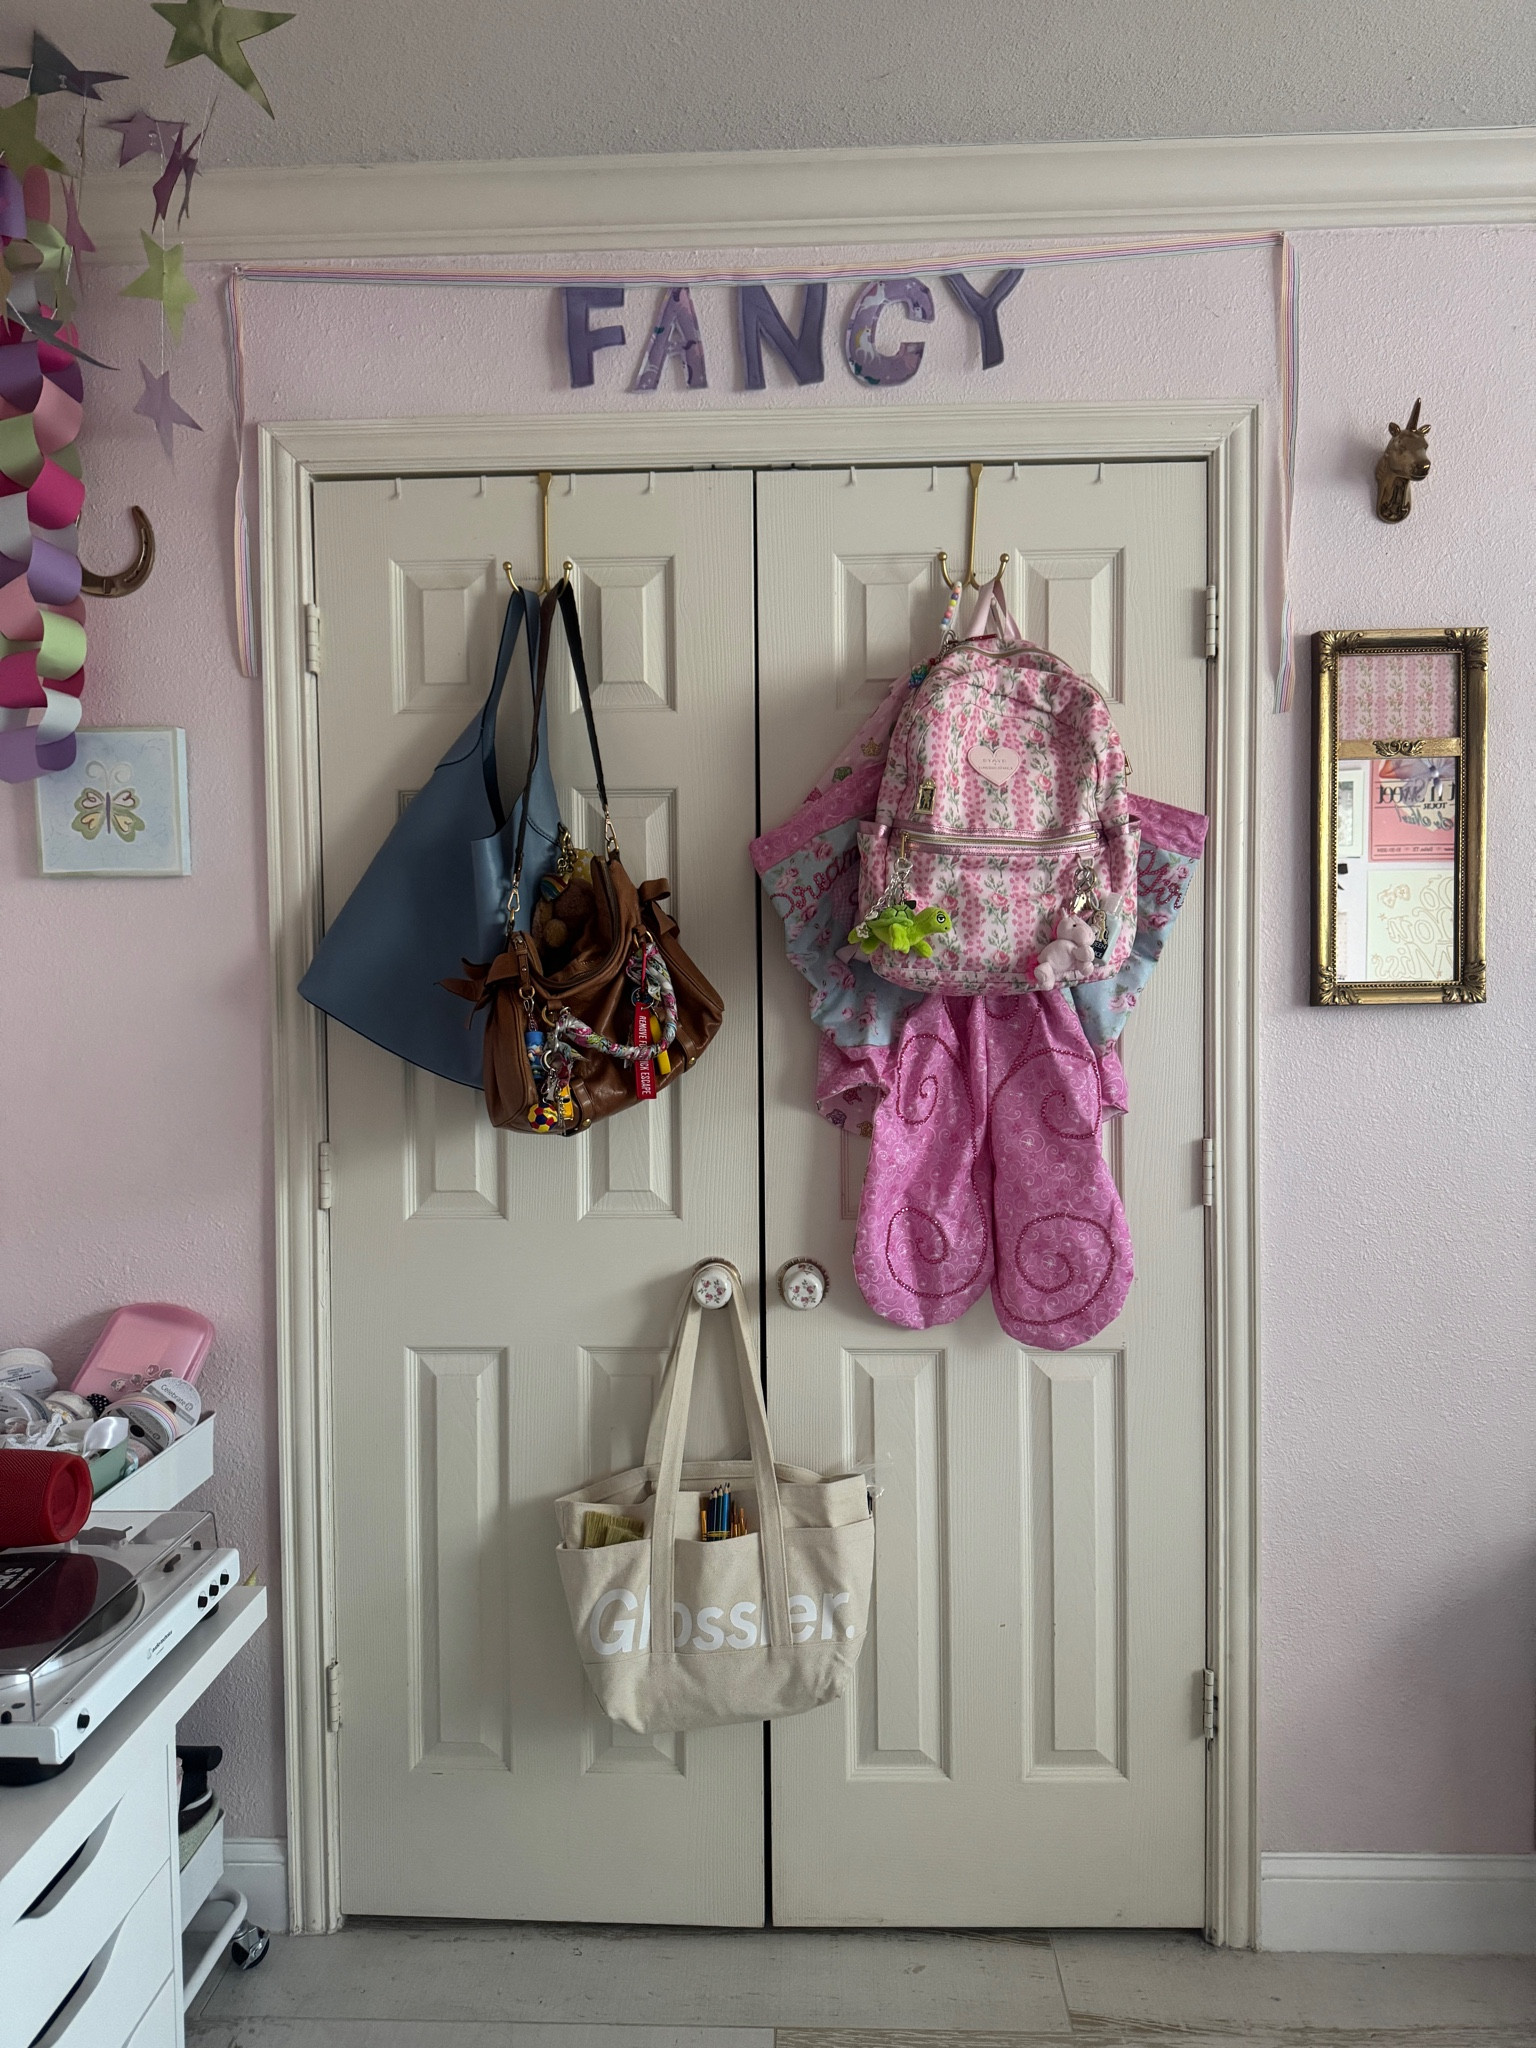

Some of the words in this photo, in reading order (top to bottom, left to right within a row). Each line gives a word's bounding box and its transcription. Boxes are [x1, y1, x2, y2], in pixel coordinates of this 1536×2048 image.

[559, 269, 1025, 392] FANCY
[639, 1015, 648, 1039] REMOVE
[640, 1072, 651, 1095] ESCAPE
[160, 1384, 186, 1406] Celebrate
